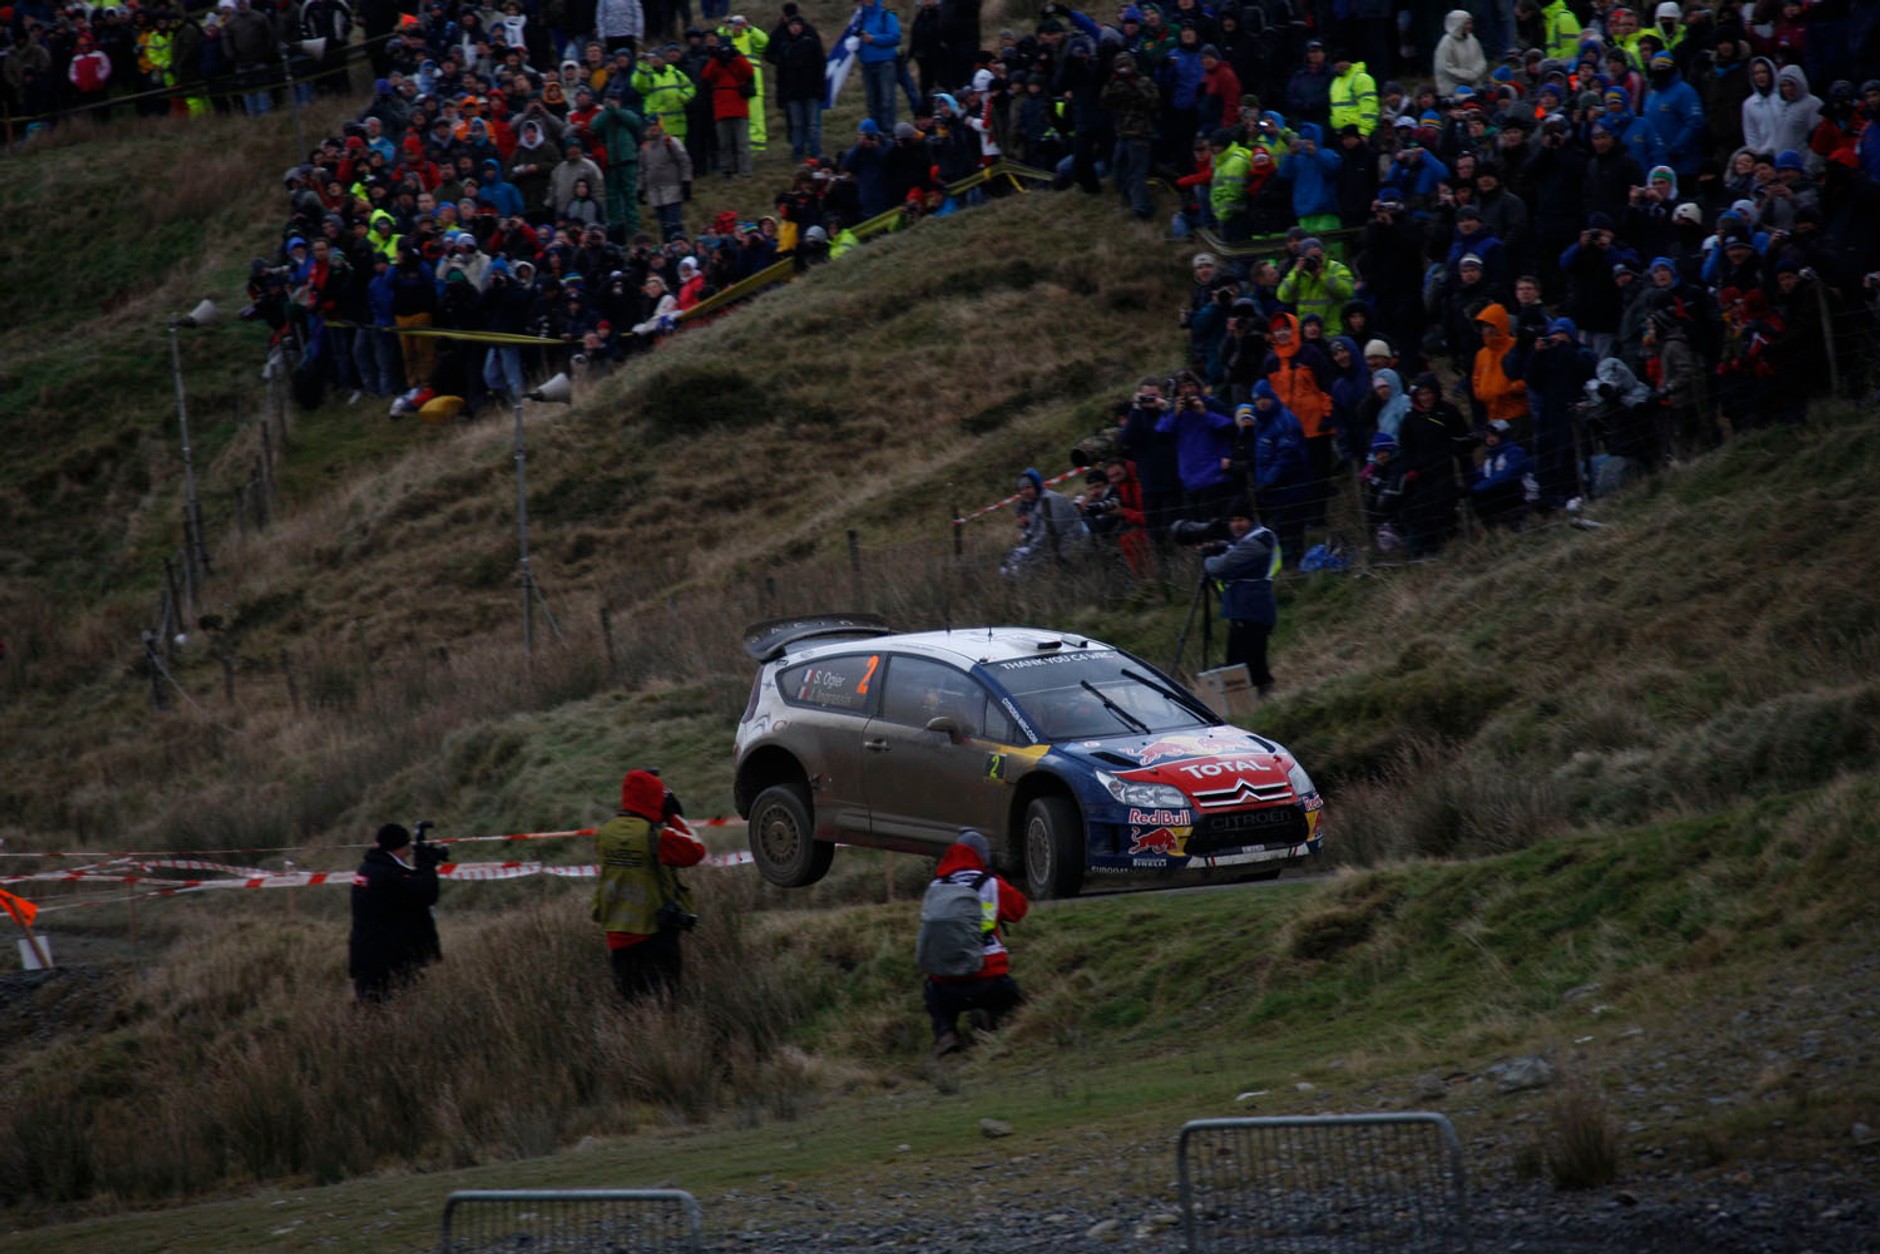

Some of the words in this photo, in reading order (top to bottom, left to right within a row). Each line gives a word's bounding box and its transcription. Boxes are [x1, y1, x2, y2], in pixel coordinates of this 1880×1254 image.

[1000, 658, 1046, 671] THANK
[1045, 654, 1071, 665] YOU
[1071, 653, 1086, 662] C4
[813, 670, 823, 684] S.
[823, 672, 846, 689] Ogier
[856, 655, 880, 694] 2
[989, 755, 1001, 778] 2
[1180, 760, 1272, 779] TOTAL
[1128, 808, 1160, 826] Red
[1161, 809, 1191, 826] Bull
